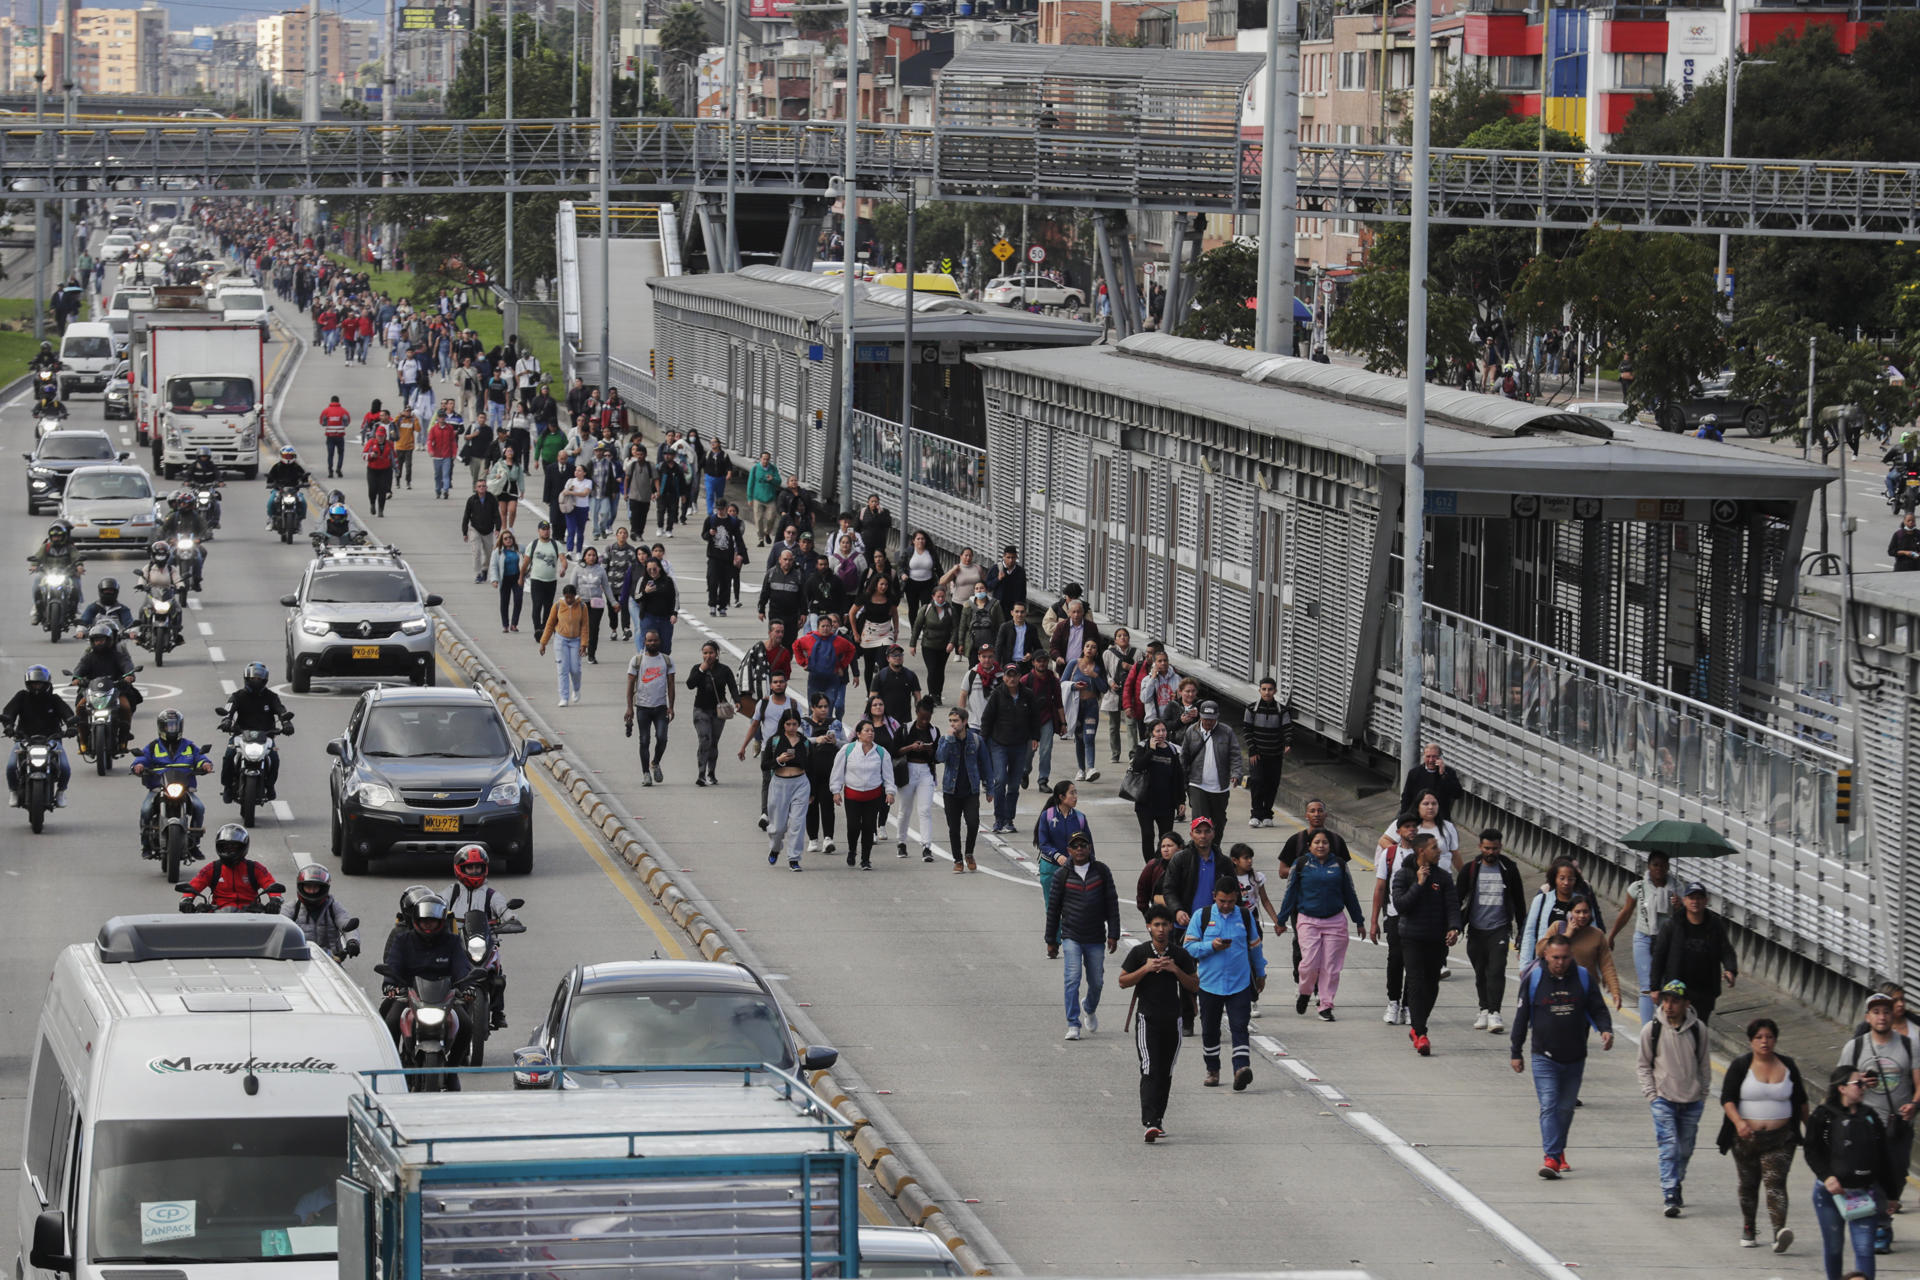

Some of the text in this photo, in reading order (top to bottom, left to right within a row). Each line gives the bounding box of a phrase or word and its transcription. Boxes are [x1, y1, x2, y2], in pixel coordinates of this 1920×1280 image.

[1031, 249, 1043, 258] 50
[425, 817, 458, 828] MKU-972
[162, 1056, 337, 1074] Marylandia
[144, 1224, 191, 1237] CANPACK
